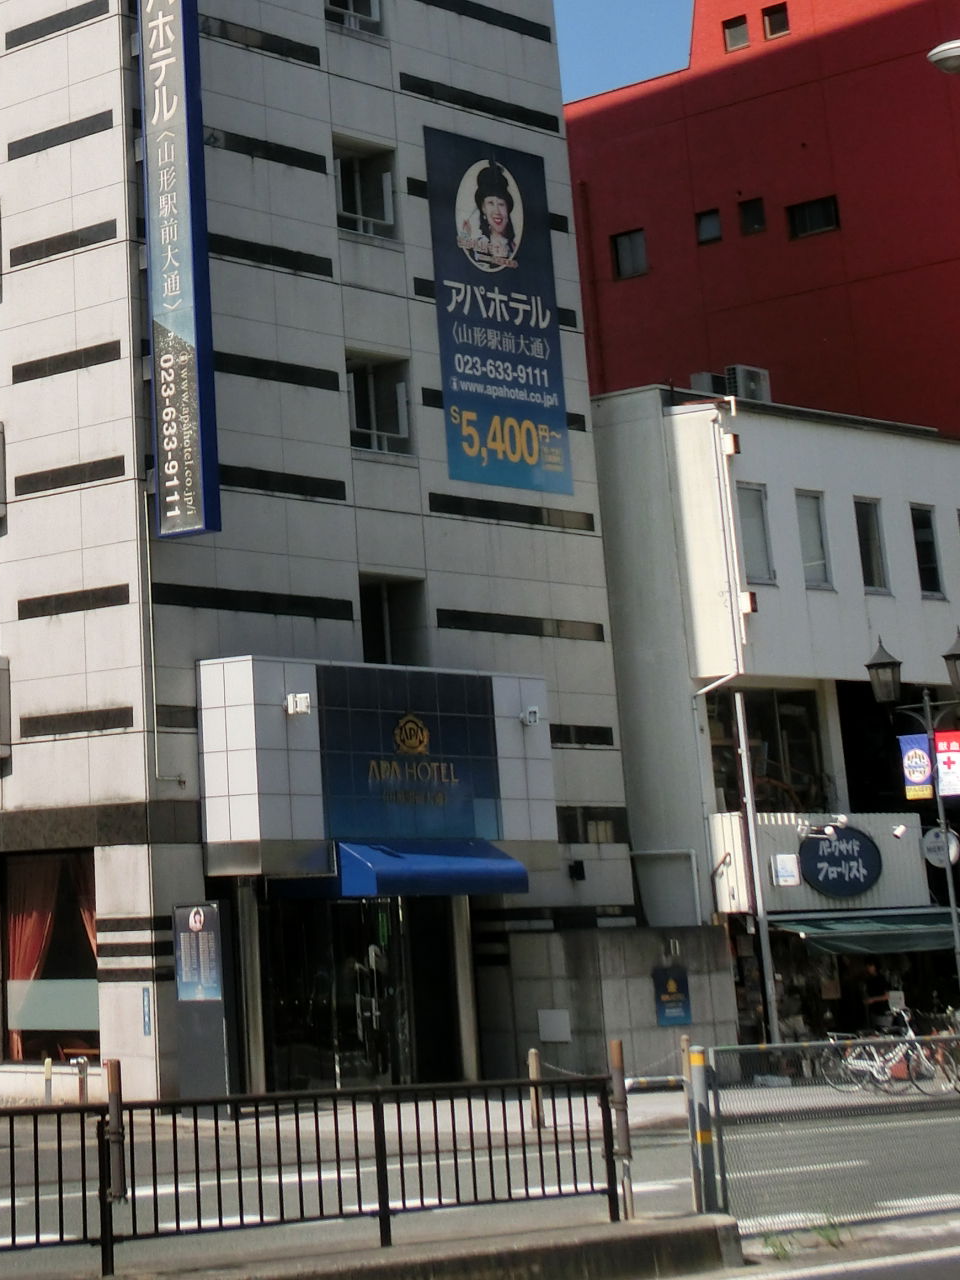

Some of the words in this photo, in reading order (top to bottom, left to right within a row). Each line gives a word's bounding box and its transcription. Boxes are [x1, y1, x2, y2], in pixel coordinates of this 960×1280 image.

[443, 279, 551, 329] アパホテル
[454, 353, 549, 388] 023-633-9111
[159, 353, 181, 519] 023-633-9111
[368, 759, 401, 783] APA
[404, 761, 460, 784] HOTEL
